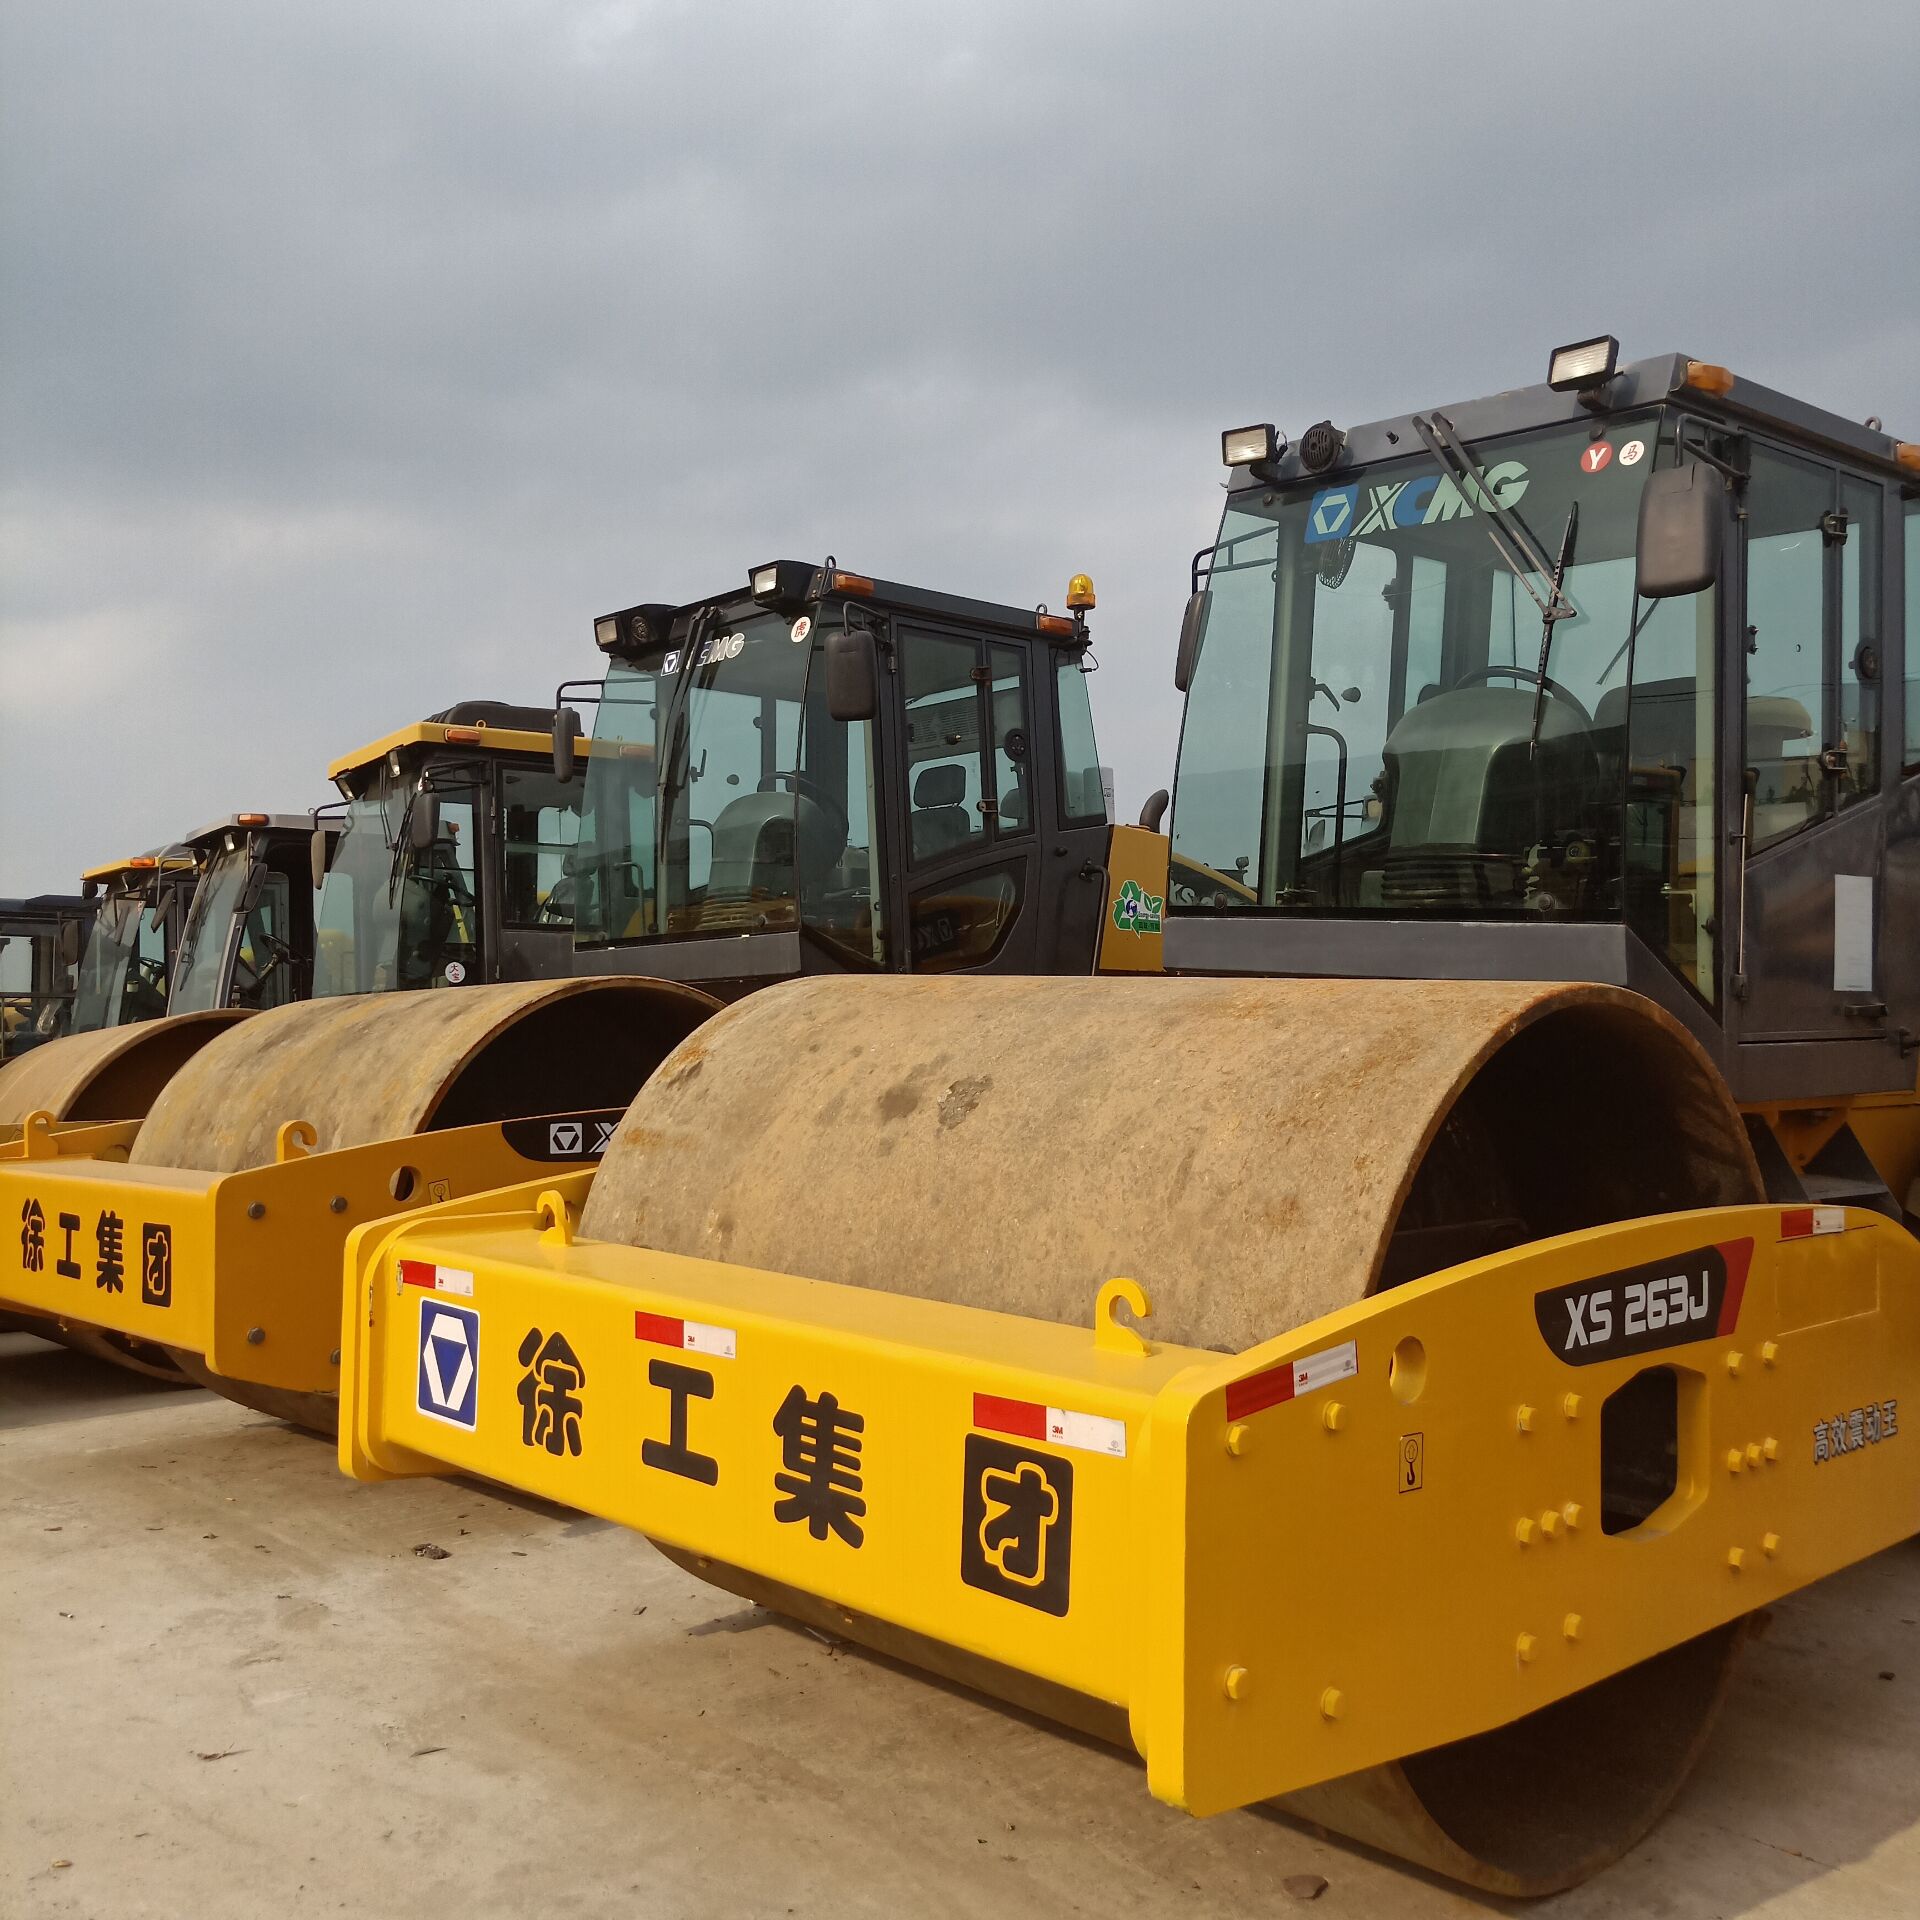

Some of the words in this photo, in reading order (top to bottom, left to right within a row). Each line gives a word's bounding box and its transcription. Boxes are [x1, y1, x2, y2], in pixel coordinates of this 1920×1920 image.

[1589, 447, 1608, 470] Y
[1623, 444, 1638, 461] 马
[1349, 461, 1530, 536] XCMG
[21, 1198, 172, 1308] 徐工集团
[1565, 1289, 1612, 1350] XS
[1625, 1270, 1708, 1335] 263J
[1052, 1425, 1063, 1435] 3M
[1813, 1400, 1898, 1464] 高效震动王
[517, 1327, 1073, 1617] 徐工集团
